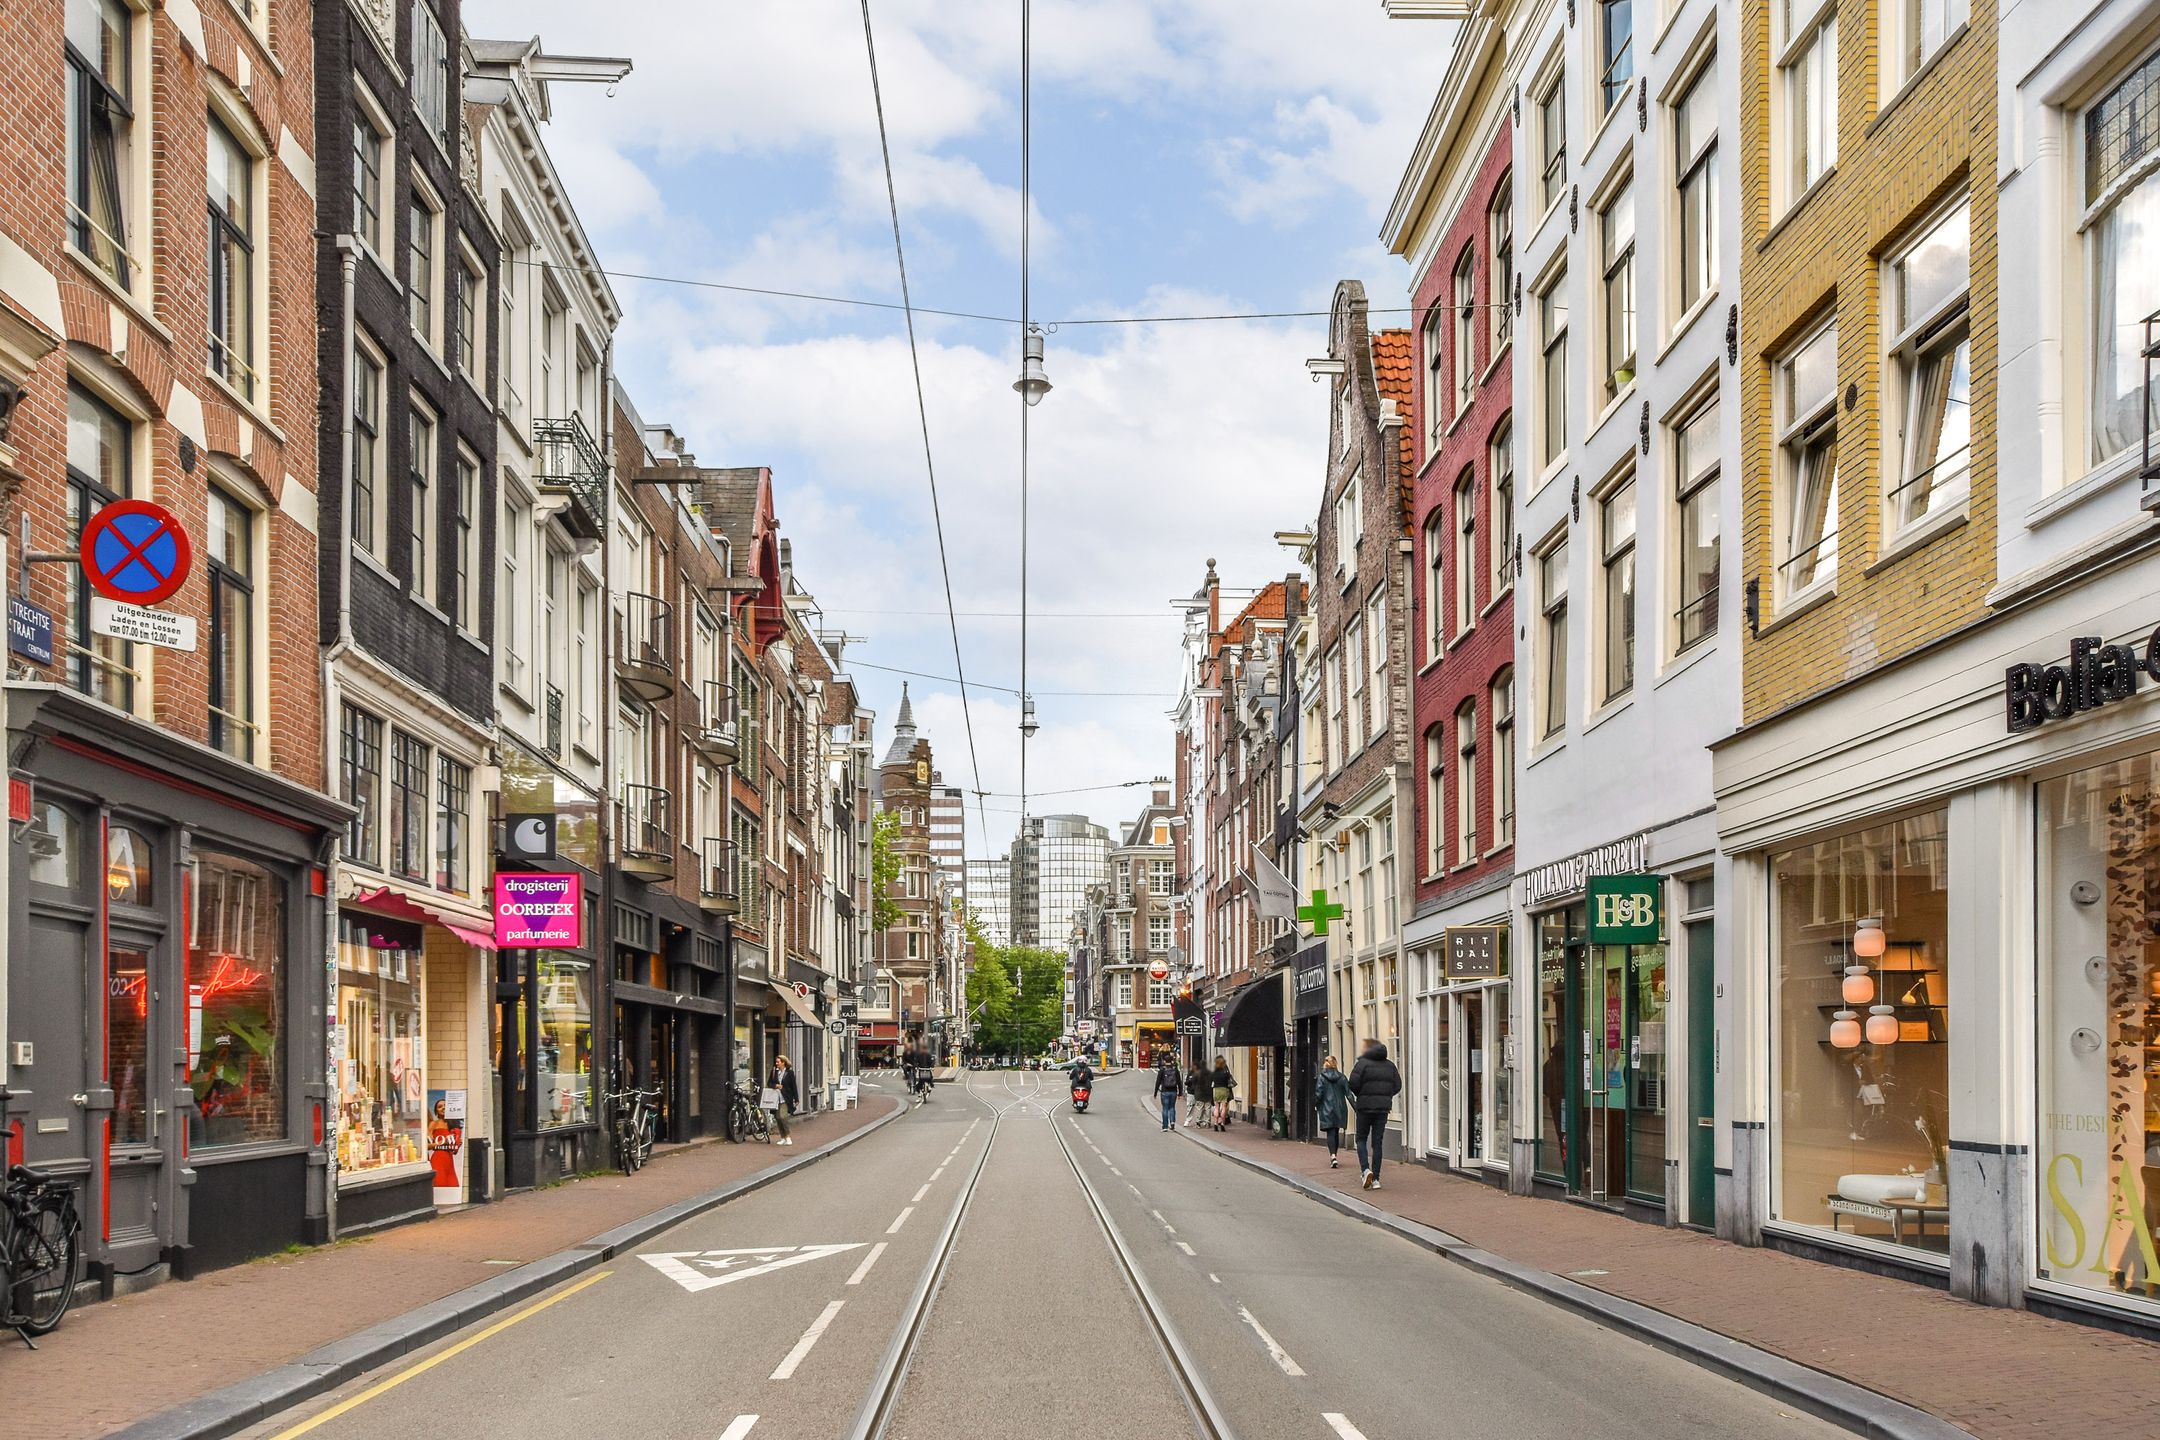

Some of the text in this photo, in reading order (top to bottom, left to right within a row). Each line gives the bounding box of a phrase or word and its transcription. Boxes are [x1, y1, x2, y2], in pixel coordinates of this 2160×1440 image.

[8, 599, 50, 631] UTRECHTSE
[111, 614, 181, 635] Laden en Lossen
[117, 605, 177, 624] Uitgezonderd
[8, 617, 36, 642] STRAAT
[109, 624, 121, 634] van
[121, 625, 139, 638] 07.00
[151, 631, 167, 643] 12.00
[167, 637, 178, 646] uur
[28, 643, 50, 660] CENTRUM
[1524, 859, 1576, 905] HOLLAND
[1588, 833, 1648, 876] BARRETT
[505, 879, 569, 895] drogisterij
[500, 903, 575, 916] OORBEEK
[1595, 893, 1655, 928] H&B
[506, 928, 570, 942] parfumerie
[1299, 972, 1308, 992] TAU
[1307, 966, 1326, 989] COTTON
[2046, 1113, 2073, 1132] THE
[1832, 1200, 1870, 1213] Scandinavian
[1870, 1207, 1891, 1218] Design
